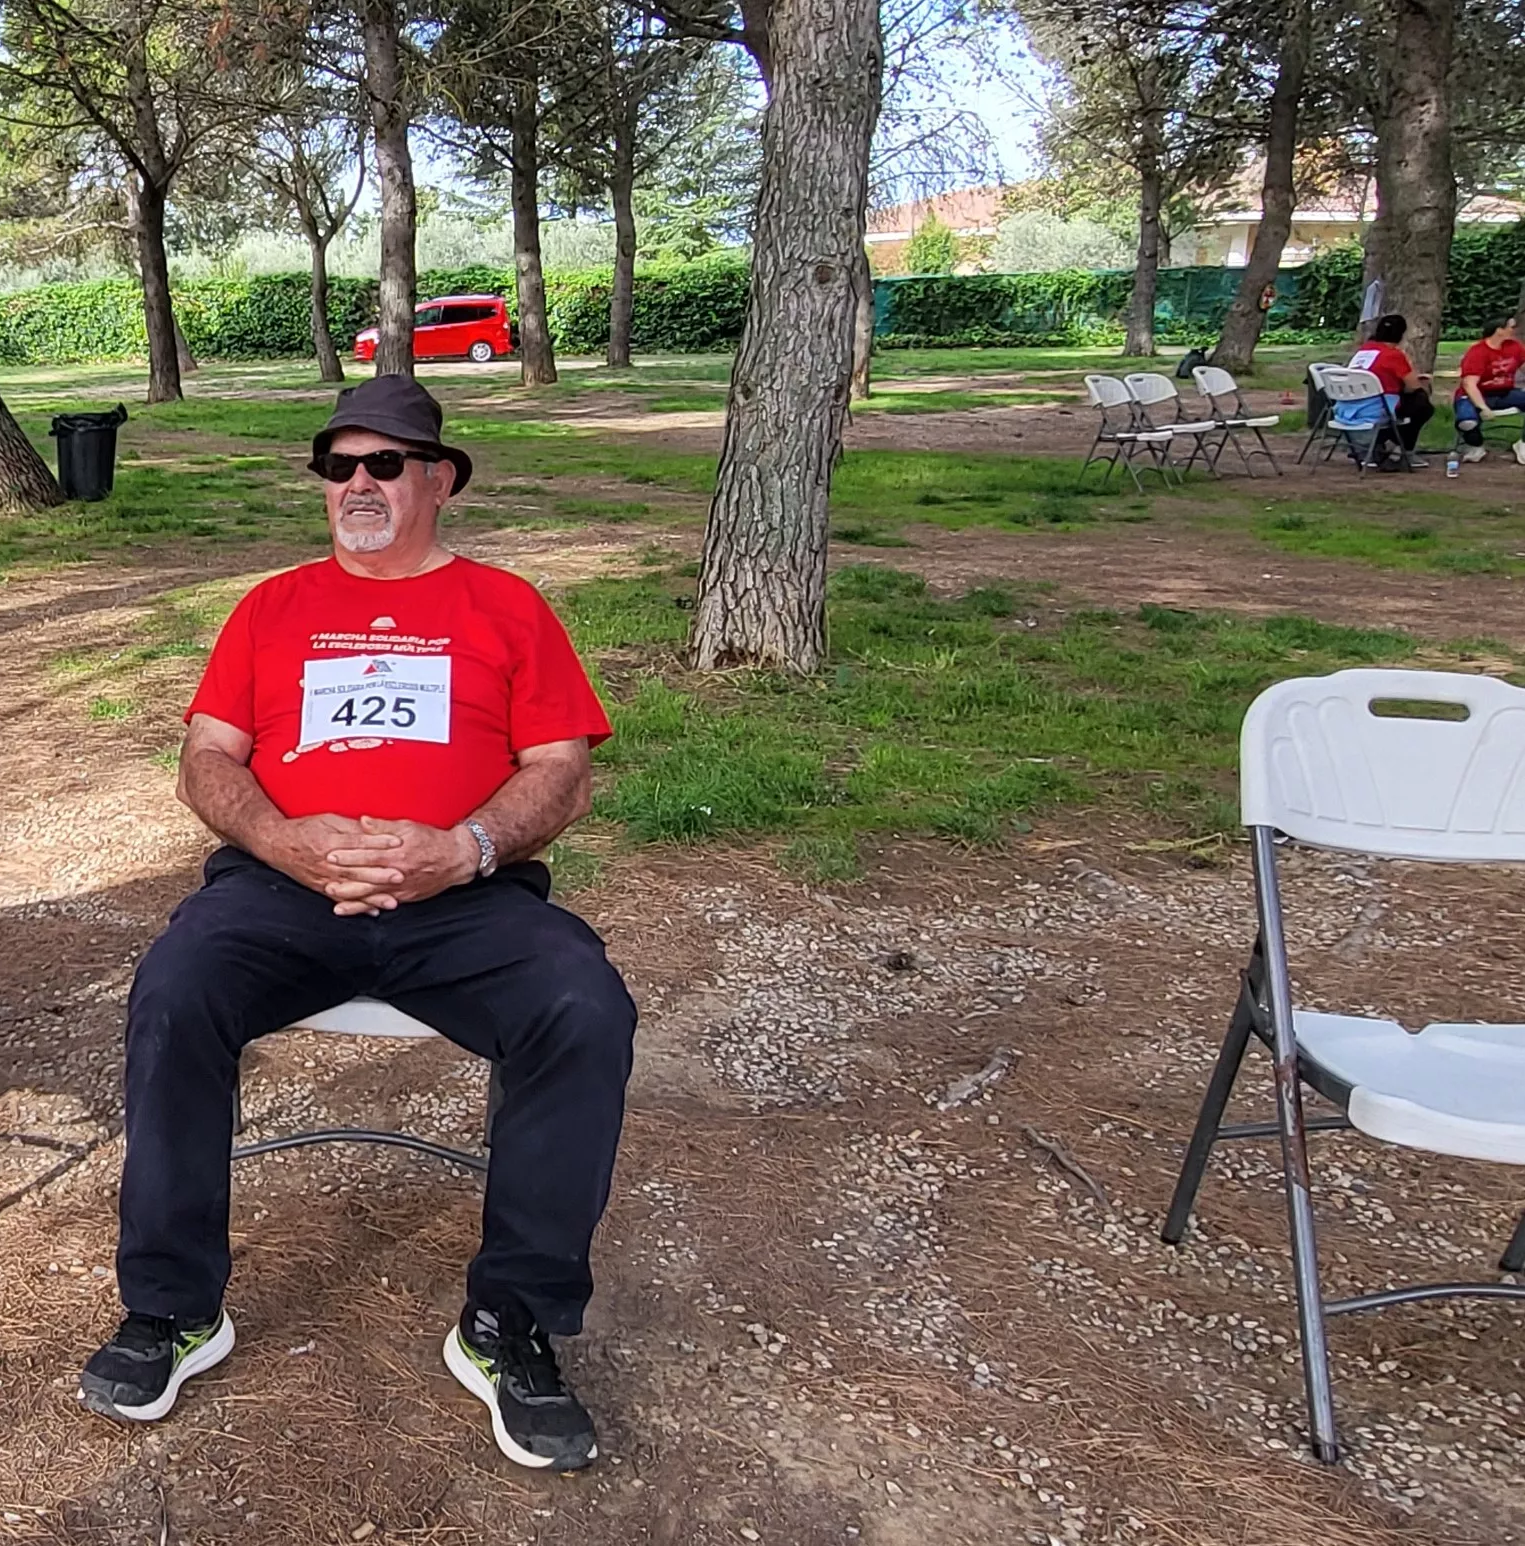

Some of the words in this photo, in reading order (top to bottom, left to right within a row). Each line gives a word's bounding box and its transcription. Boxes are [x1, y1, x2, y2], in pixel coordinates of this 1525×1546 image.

[312, 641, 326, 649] LA
[327, 641, 392, 651] ESCLEROSIS
[318, 633, 367, 641] MARCHA
[369, 634, 426, 646] SOLIDARIA
[427, 637, 452, 646] POR
[331, 696, 417, 728] 425
